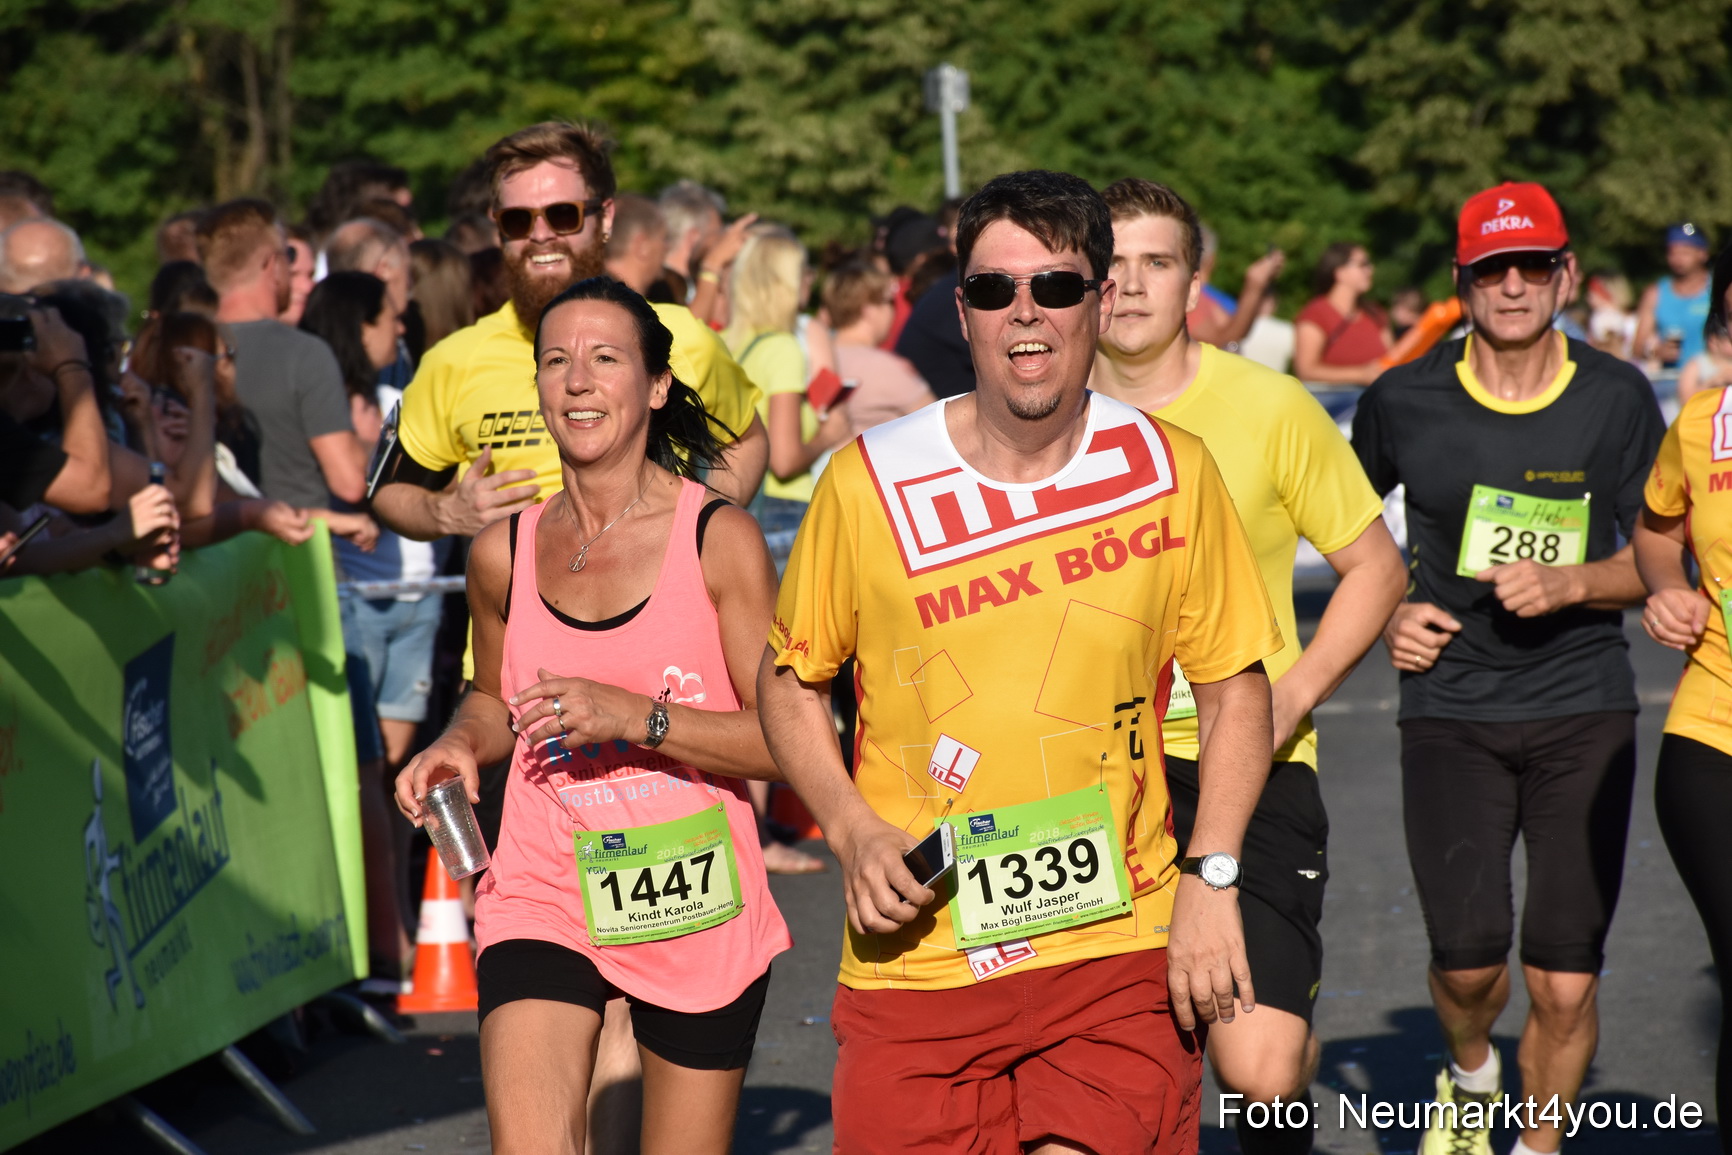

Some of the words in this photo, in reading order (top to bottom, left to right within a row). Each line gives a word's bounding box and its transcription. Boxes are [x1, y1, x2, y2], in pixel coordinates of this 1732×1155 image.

[1481, 215, 1535, 236] DEKRA
[1490, 526, 1560, 563] 288
[914, 560, 1043, 629] MAX
[1055, 516, 1186, 585] BÖGL
[1171, 690, 1191, 699] dikt
[559, 772, 715, 808] Postbauer-Heng
[961, 825, 1020, 845] firmenlauf
[1029, 827, 1060, 843] 2018
[595, 844, 648, 858] firmenlauf
[657, 845, 684, 860] 2018
[600, 851, 715, 911] 1447
[967, 838, 1100, 904] 1339
[628, 910, 661, 922] Kindt
[664, 901, 703, 917] Karola
[981, 922, 999, 930] Max
[1001, 916, 1022, 926] Bögl
[1025, 906, 1074, 922] Bauservice
[1076, 897, 1103, 910] GmbH
[1001, 901, 1031, 915] Wulf
[1036, 891, 1080, 909] Jasper
[620, 918, 681, 932] Seniorenzentrum
[683, 900, 734, 921] Postbauer-Heng
